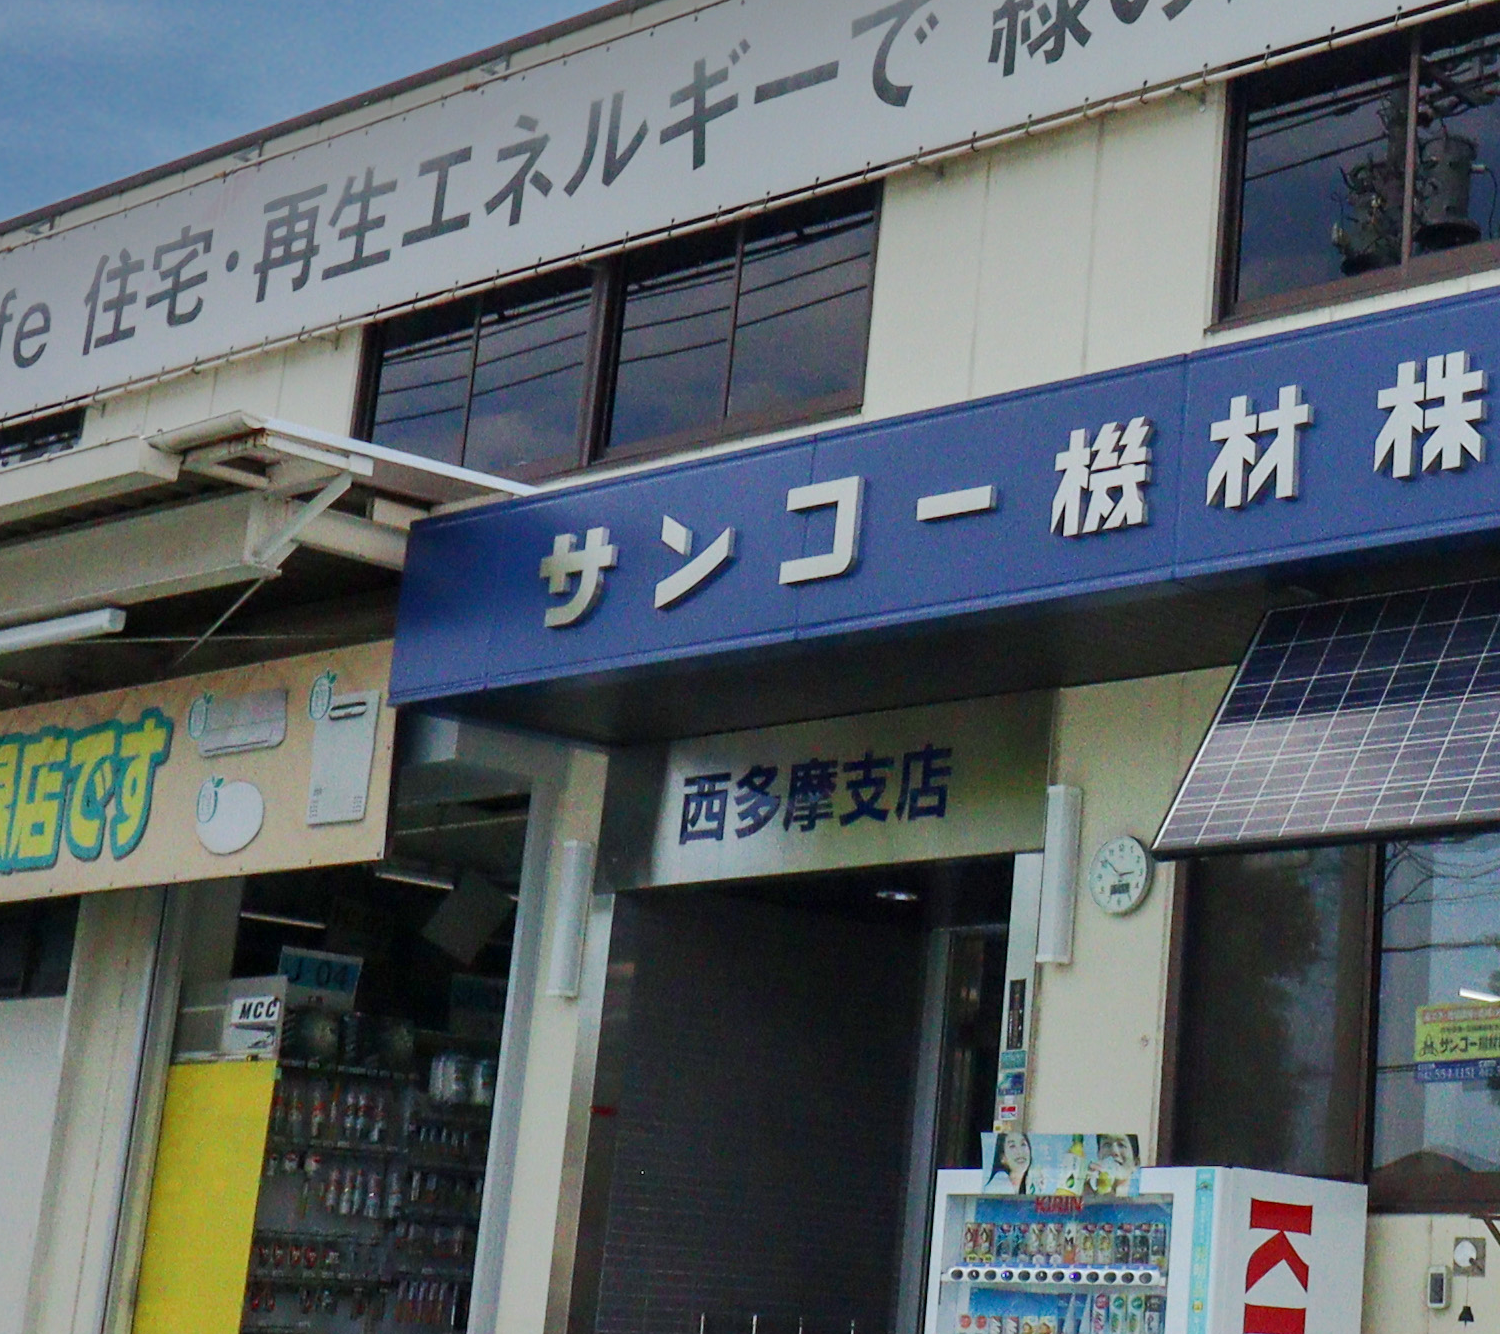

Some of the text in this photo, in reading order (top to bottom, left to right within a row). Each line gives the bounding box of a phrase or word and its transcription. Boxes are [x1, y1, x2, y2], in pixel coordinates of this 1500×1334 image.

[679, 743, 953, 845] 西多摩支店
[238, 1000, 277, 1020] MCC
[1034, 1195, 1085, 1214] KIRIN
